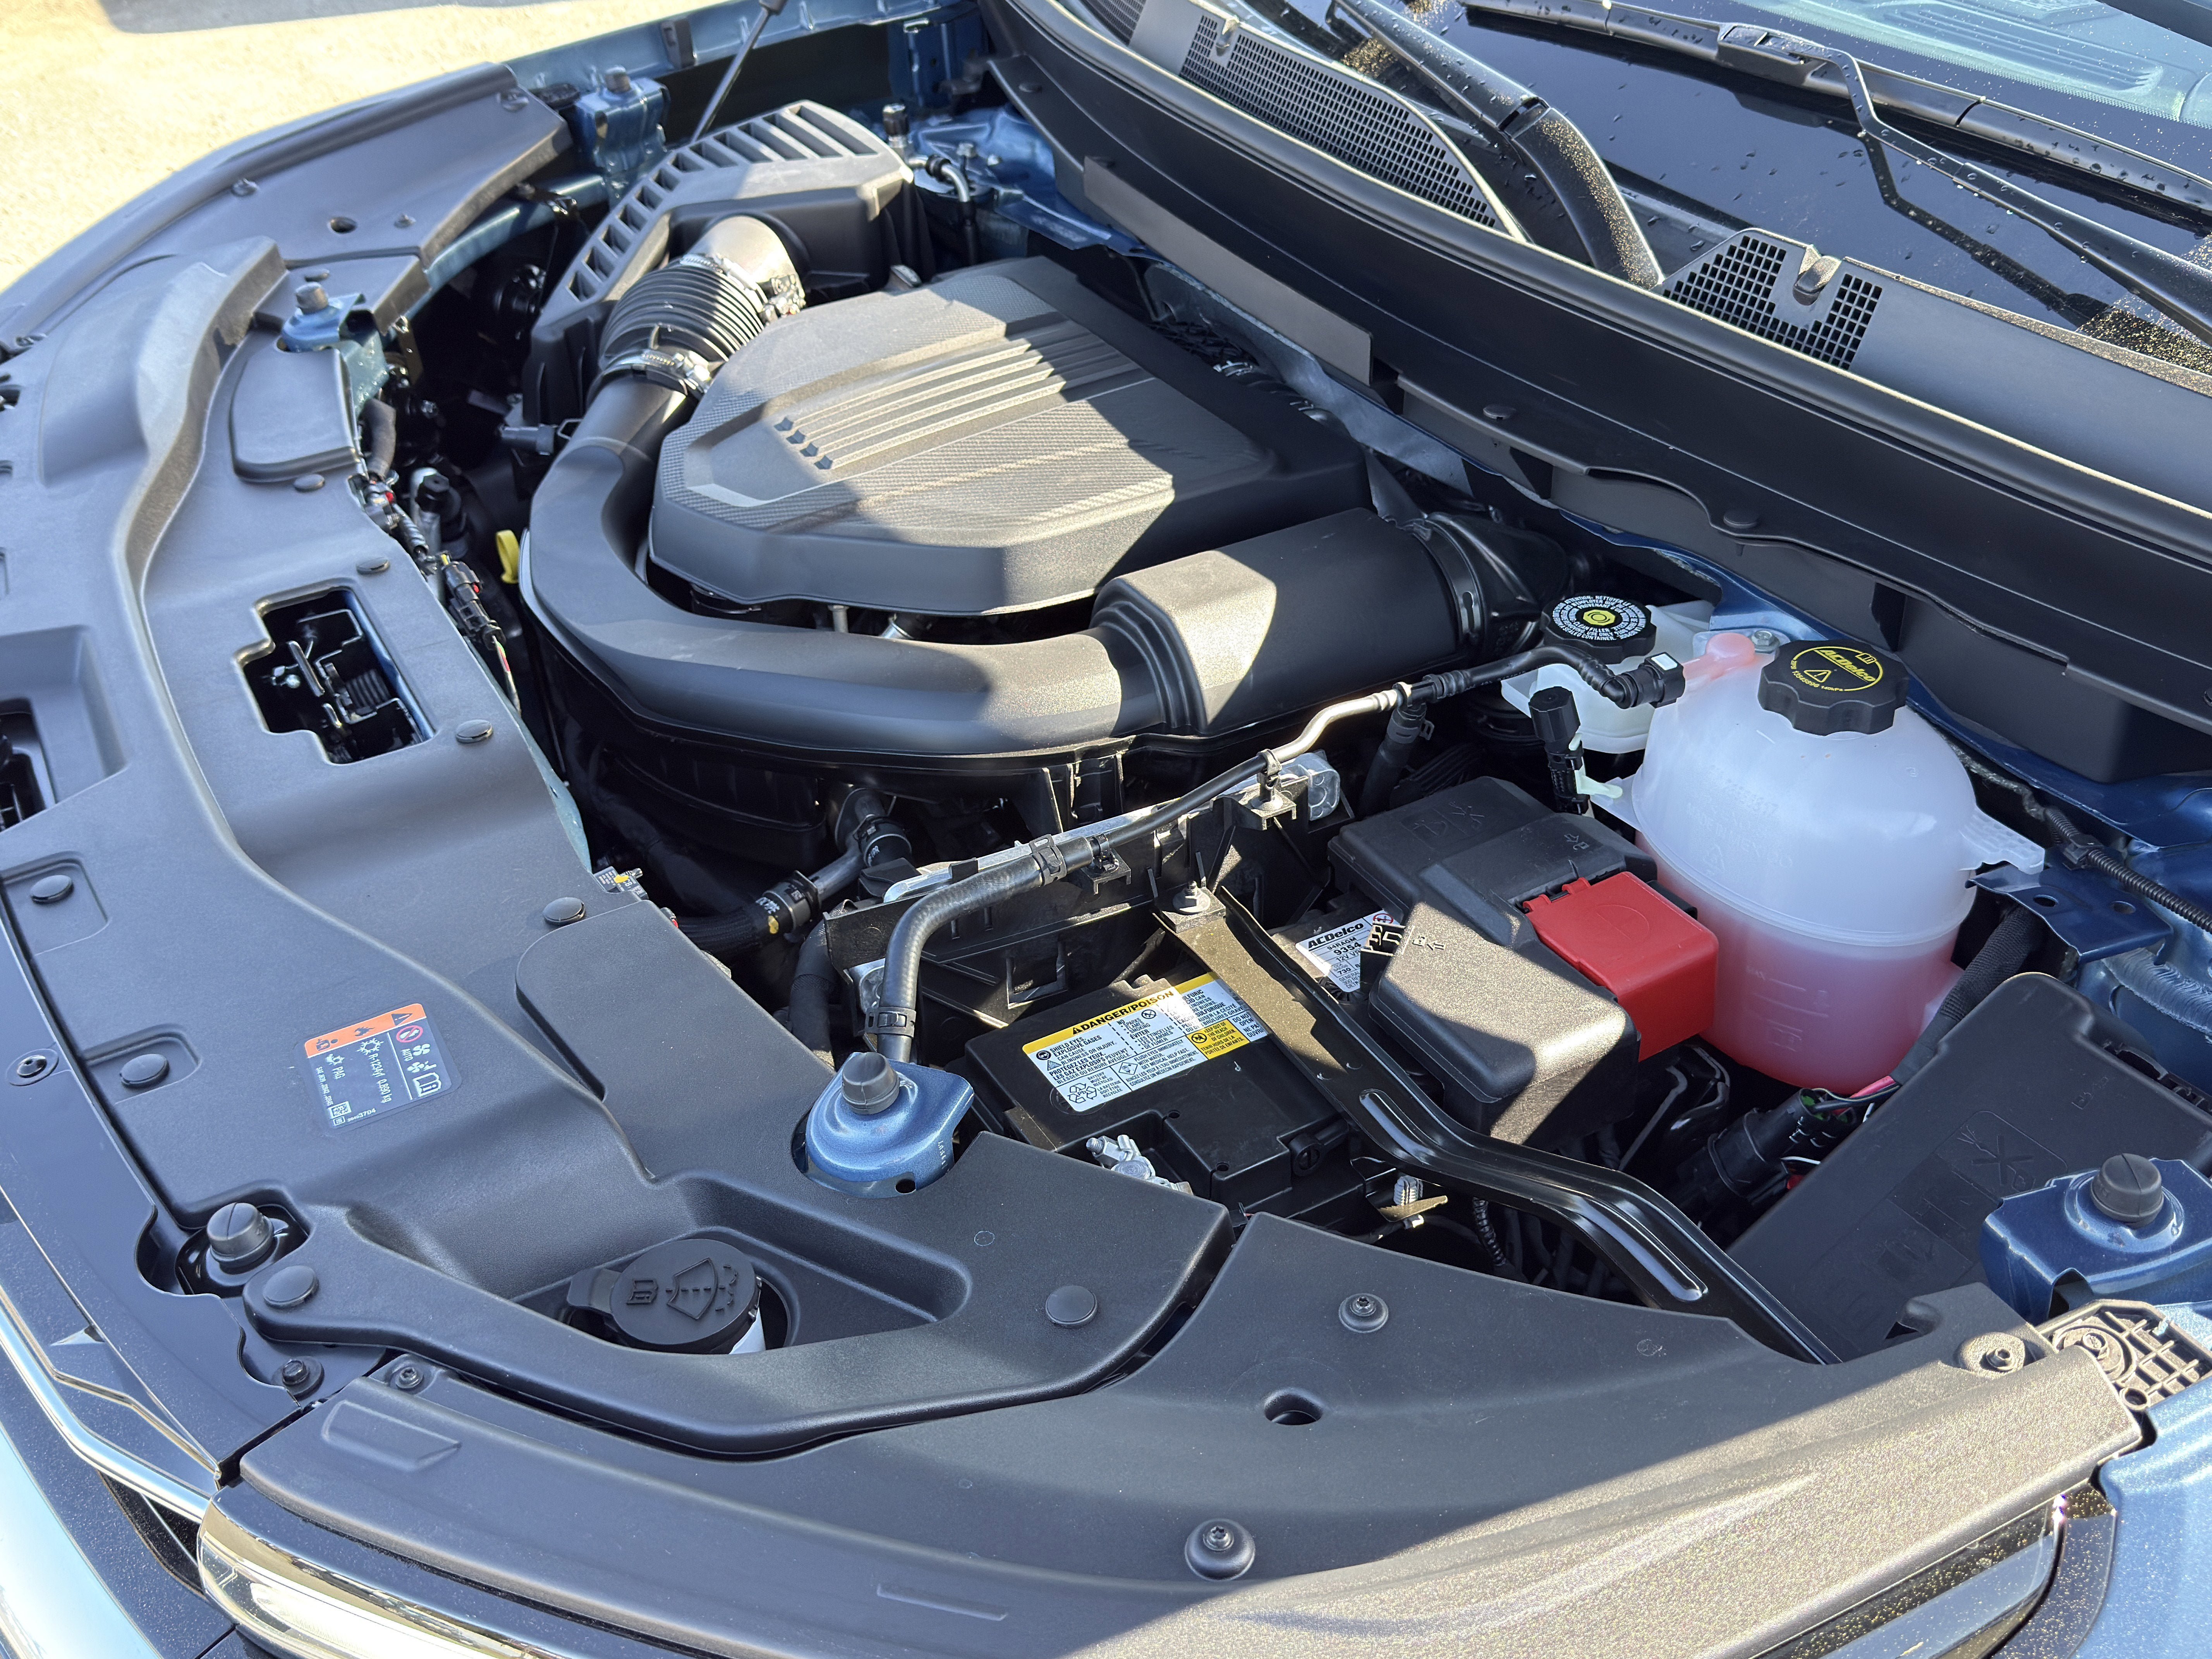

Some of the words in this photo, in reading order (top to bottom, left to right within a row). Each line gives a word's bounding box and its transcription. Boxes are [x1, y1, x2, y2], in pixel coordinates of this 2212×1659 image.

[1819, 650, 1876, 682] ACDelco
[1308, 923, 1364, 948] ACDelco
[1327, 936, 1357, 950] 94RAGM
[1333, 942, 1362, 955] 9354
[1336, 954, 1349, 962] 12V
[1183, 989, 1204, 1000] ULFURIC
[1081, 992, 1173, 1030] DANGER/POISON
[1195, 1002, 1226, 1017] SULFURIQUE
[1199, 1001, 1218, 1010] BURNS.
[1198, 1013, 1214, 1022] AUSER
[1219, 1003, 1237, 1013] CÉCITÉ
[1202, 1013, 1228, 1025] BRÛLURES
[1123, 1018, 1141, 1027] SPARKS
[1126, 1021, 1144, 1030] FLAMES
[1239, 1017, 1254, 1026] OPEN
[1129, 1023, 1151, 1034] SMOKING
[1130, 1029, 1150, 1039] ÉVITER
[1145, 1025, 1174, 1039] ÉTINCELLES
[1150, 1030, 1173, 1042] FLAMMES
[1151, 1037, 1168, 1046] FUMER
[1050, 1043, 1070, 1053] SHIELD
[1069, 1037, 1086, 1045] EYES.
[1053, 1042, 1084, 1057] EXPLOSIVE
[1083, 1035, 1102, 1045] GASES
[1133, 1054, 1148, 1062] FLUSH
[1157, 1039, 1183, 1052] IMMEDIATELY
[1203, 1045, 1221, 1055] PORTÉE
[1224, 1037, 1244, 1047] ENFANTS.
[401, 1048, 413, 1061] AUTO
[1061, 1051, 1089, 1065] BLINDNESS
[1068, 1048, 1085, 1057] CAUSE
[368, 1053, 385, 1077] R-1234yf
[1049, 1062, 1078, 1076] PROTÉGEZ
[1088, 1052, 1106, 1060] YEUX.
[1075, 1057, 1106, 1072] EXPLOSIFS
[1105, 1048, 1128, 1060] PEUVENT
[1149, 1057, 1168, 1066] MEDICAL
[331, 1066, 346, 1080] PAG
[1056, 1073, 1080, 1084] BLESSER
[1087, 1061, 1108, 1072] RENDRE
[1108, 1053, 1132, 1064] AVEUGLE.
[1087, 1072, 1104, 1080] BATTERY
[1093, 1077, 1113, 1087] RECYCLED
[1126, 1074, 1140, 1082] RINCEZ
[1130, 1075, 1151, 1086] CONSULTEZ
[1156, 1066, 1173, 1075] MÉDECIN
[376, 1078, 392, 1094] 0.890
[1103, 1080, 1121, 1089] BATTERIE
[381, 1093, 393, 1103] kg
[1103, 1088, 1123, 1098] RECYCLÉE
